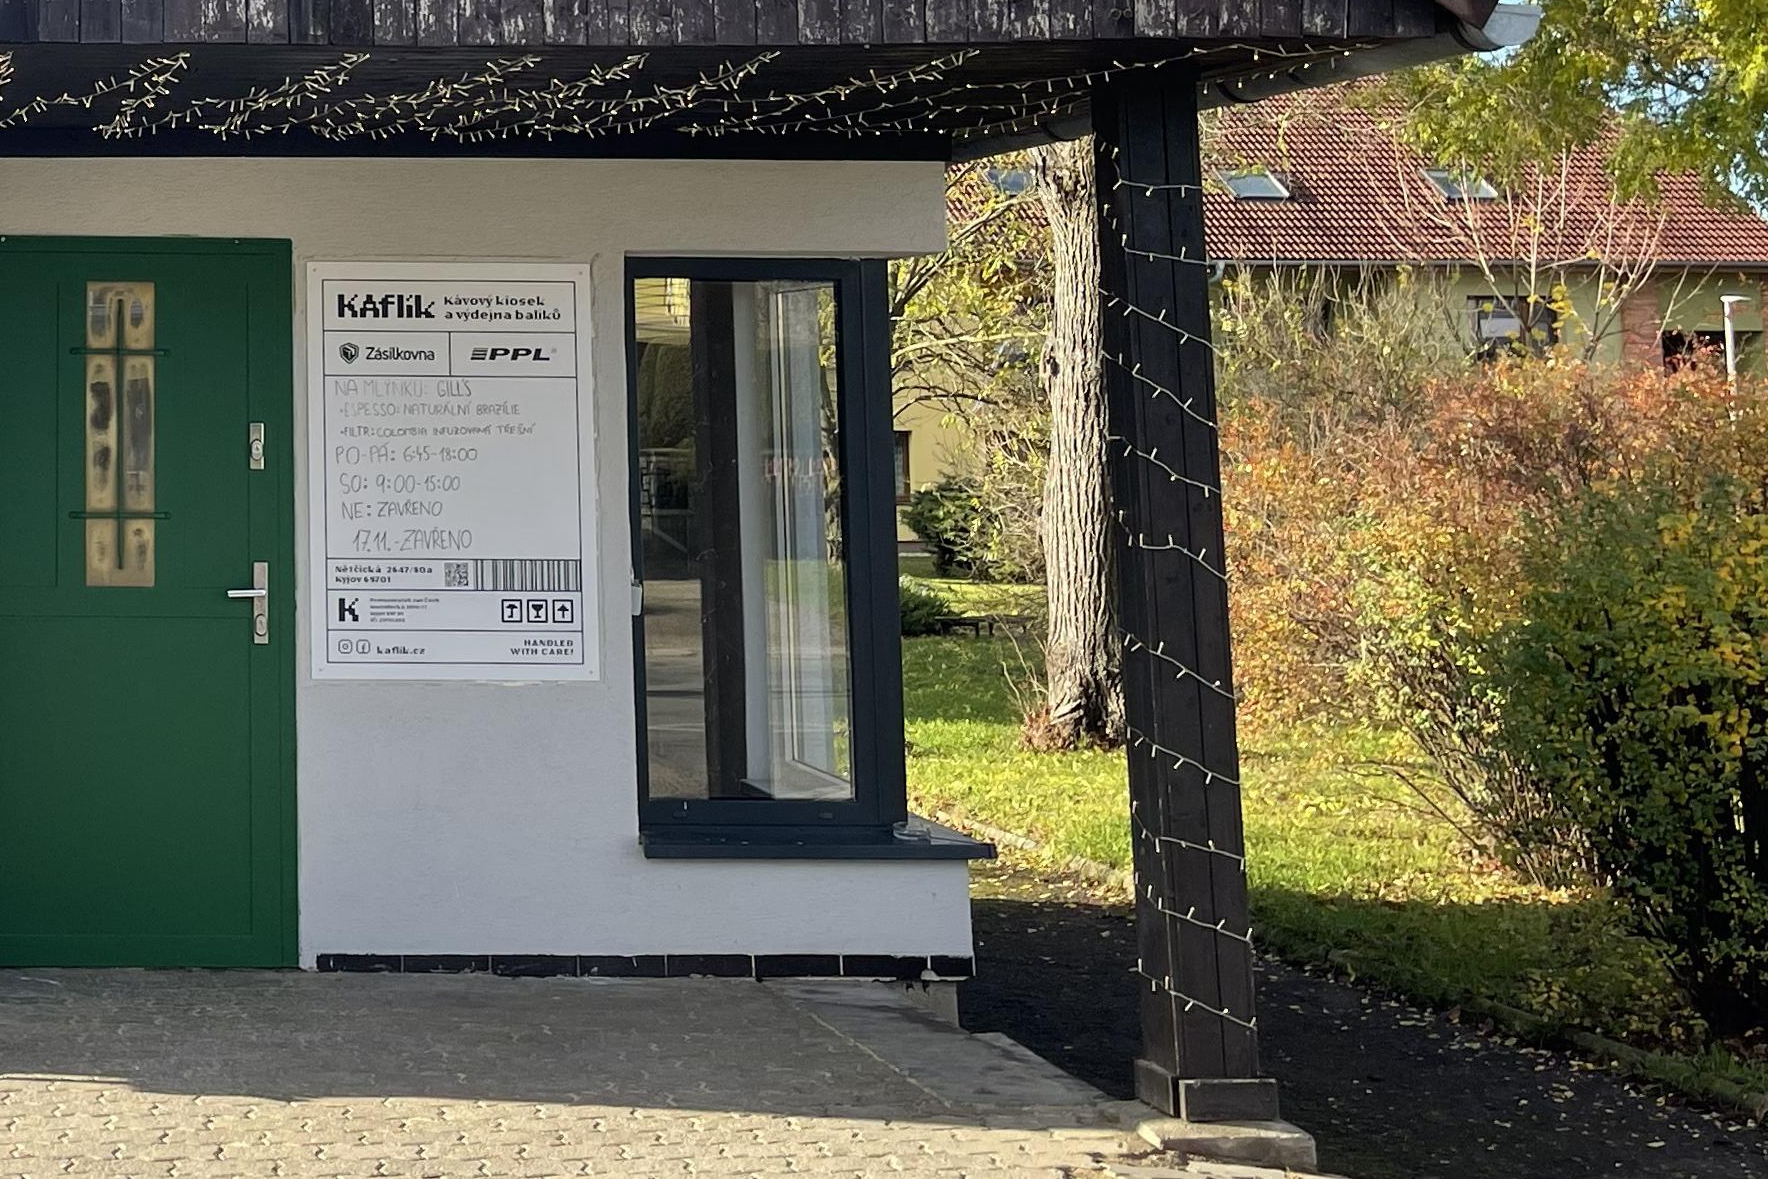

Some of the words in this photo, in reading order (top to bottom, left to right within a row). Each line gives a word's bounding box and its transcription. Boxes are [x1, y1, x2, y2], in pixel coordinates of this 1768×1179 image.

[444, 294, 493, 308] Kávový
[495, 295, 545, 306] kiosek
[444, 311, 453, 320] a
[455, 308, 512, 322] výdejna
[365, 345, 435, 361] Zásilkovna
[489, 347, 550, 361] PPL
[335, 379, 358, 397] NA
[339, 473, 368, 495] SO:
[376, 474, 461, 494] 9:00-15:00
[341, 502, 371, 521] NE:
[377, 499, 444, 518] ZAVŘENO
[338, 597, 360, 622] K
[524, 639, 574, 647] HANDLED
[510, 648, 538, 656] WITH
